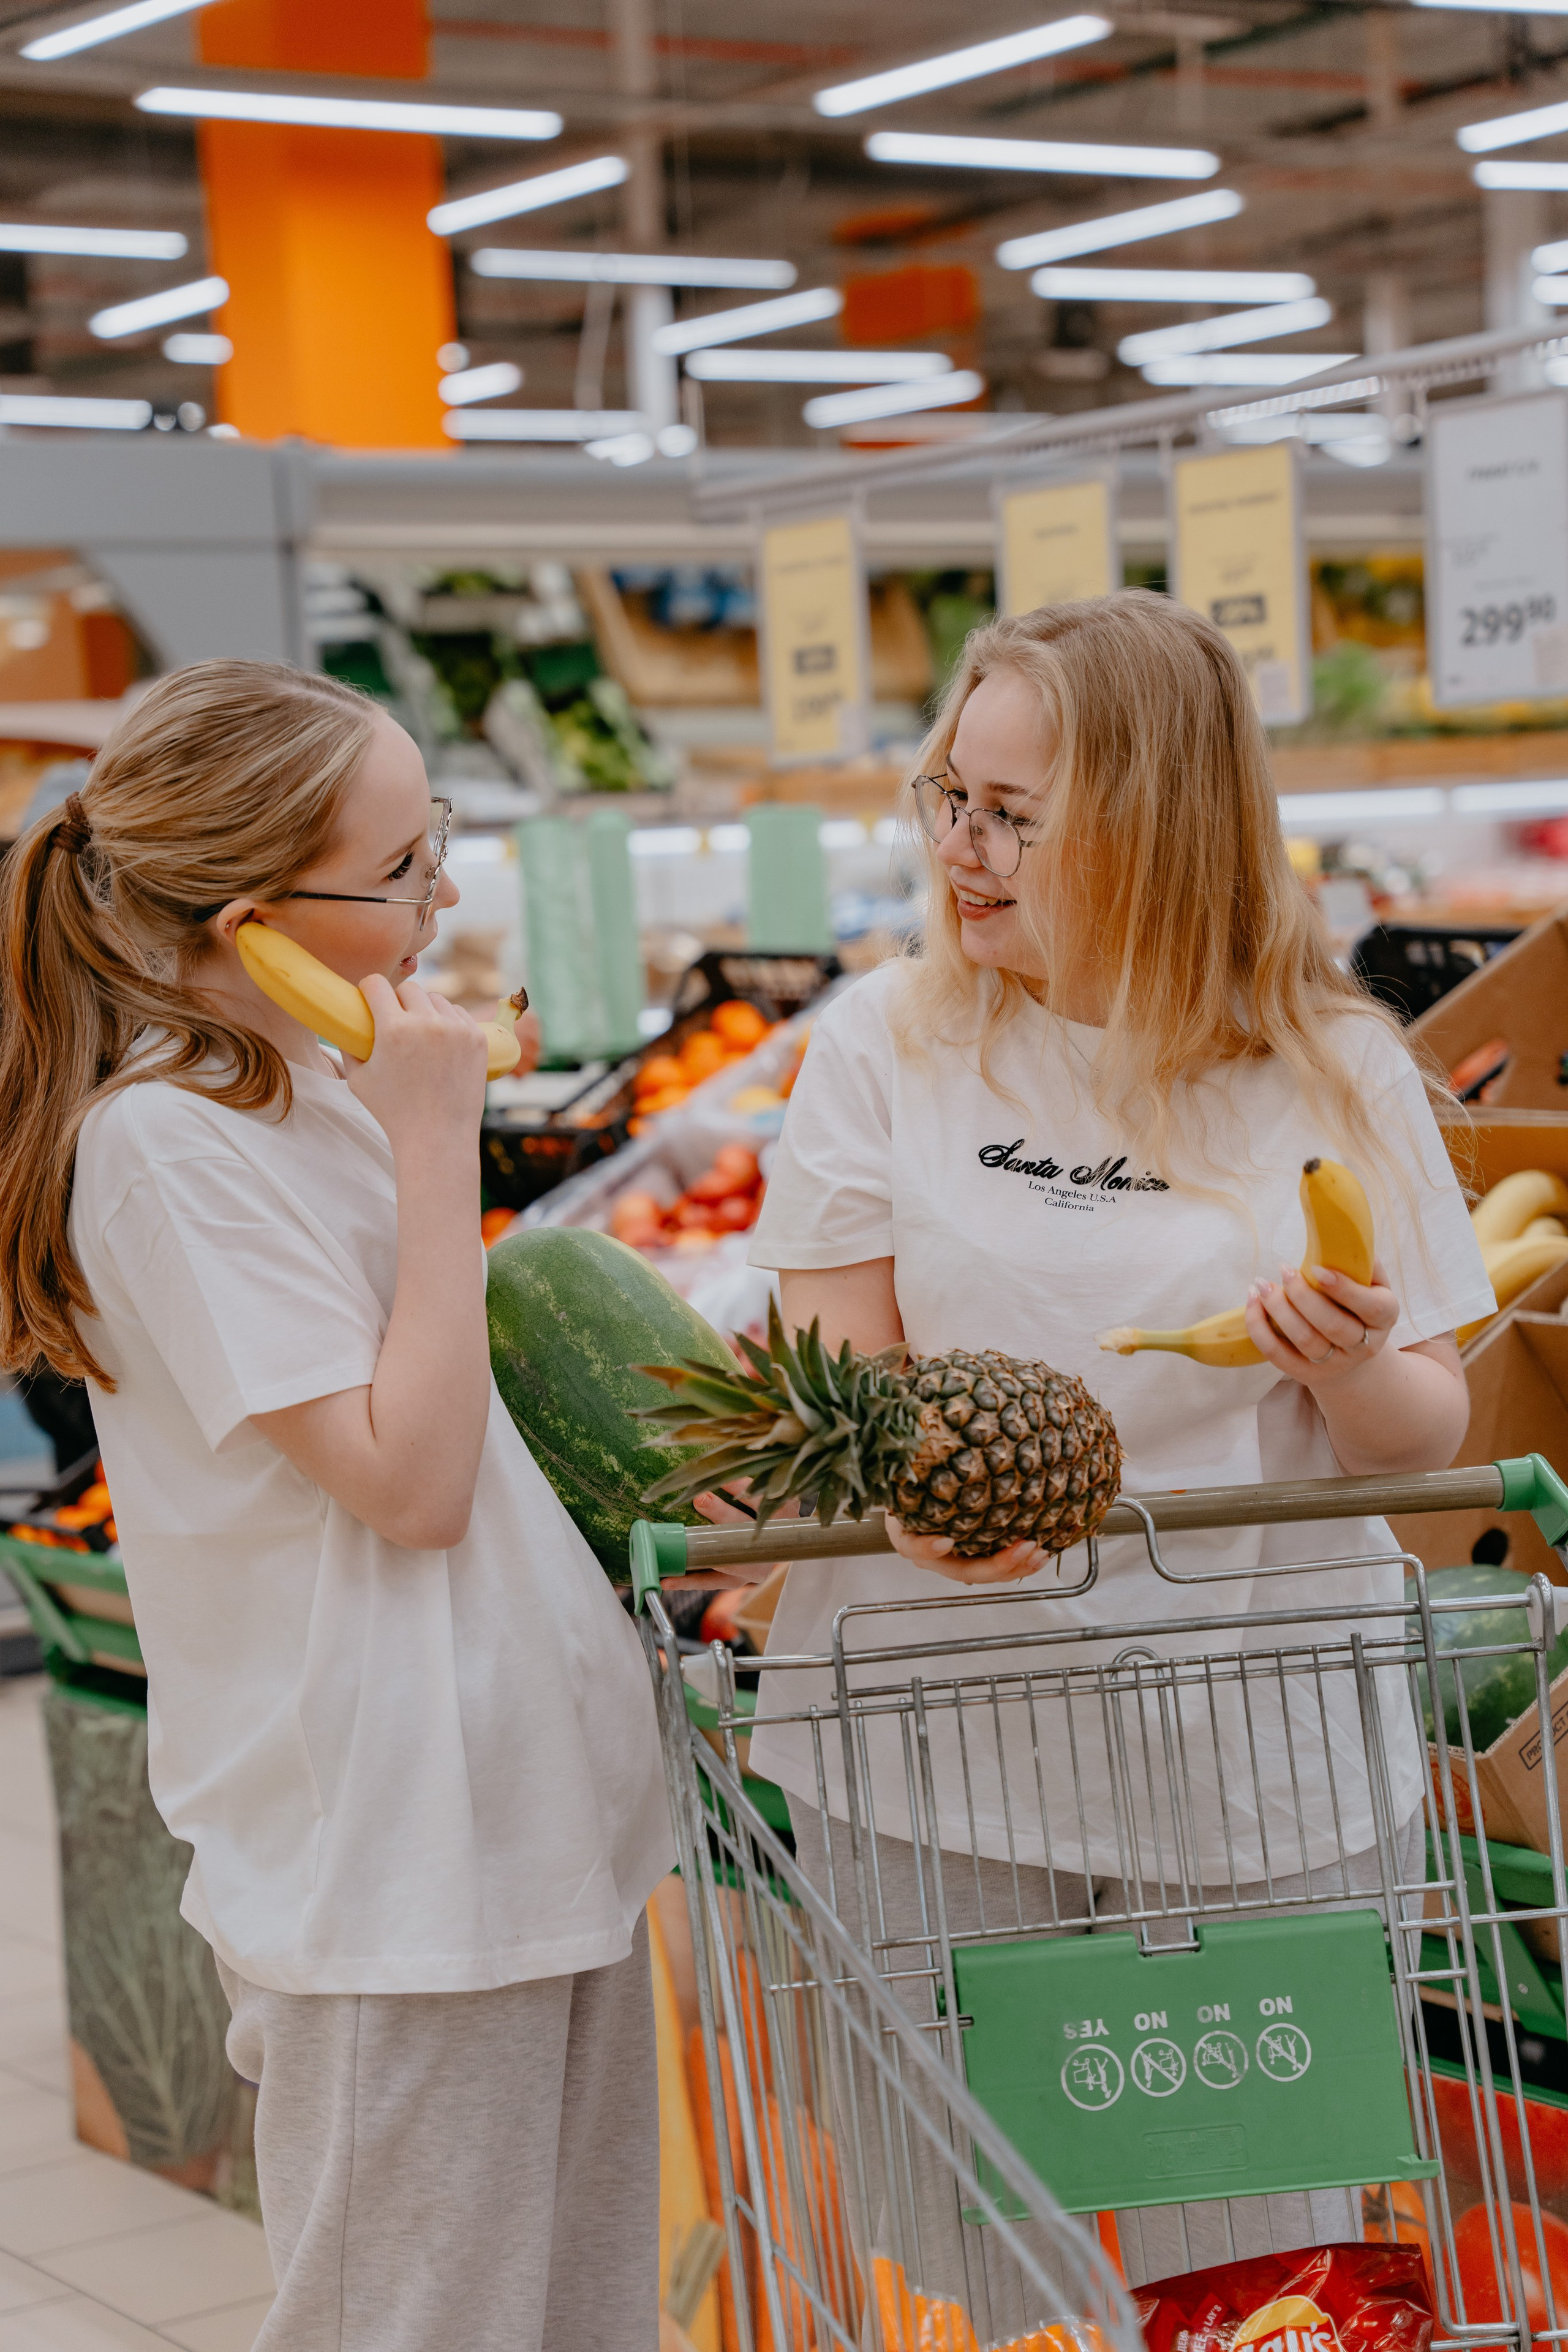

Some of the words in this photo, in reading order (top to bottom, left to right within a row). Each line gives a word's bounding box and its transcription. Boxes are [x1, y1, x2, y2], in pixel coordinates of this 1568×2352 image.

[978, 1139, 1064, 1179] Santa
[1069, 1156, 1170, 1192] Monica
[1028, 1181, 1046, 1192] Los
[1047, 1186, 1087, 1199] Angeles
[1090, 1193, 1117, 1204] U.S.A
[1044, 1197, 1095, 1212] California
[1197, 2003, 1231, 2023] NO
[1259, 1996, 1293, 2016] NO
[1063, 2018, 1110, 2040] YES
[1134, 2011, 1168, 2031] NO
[1204, 2304, 1222, 2326] LAY'S
